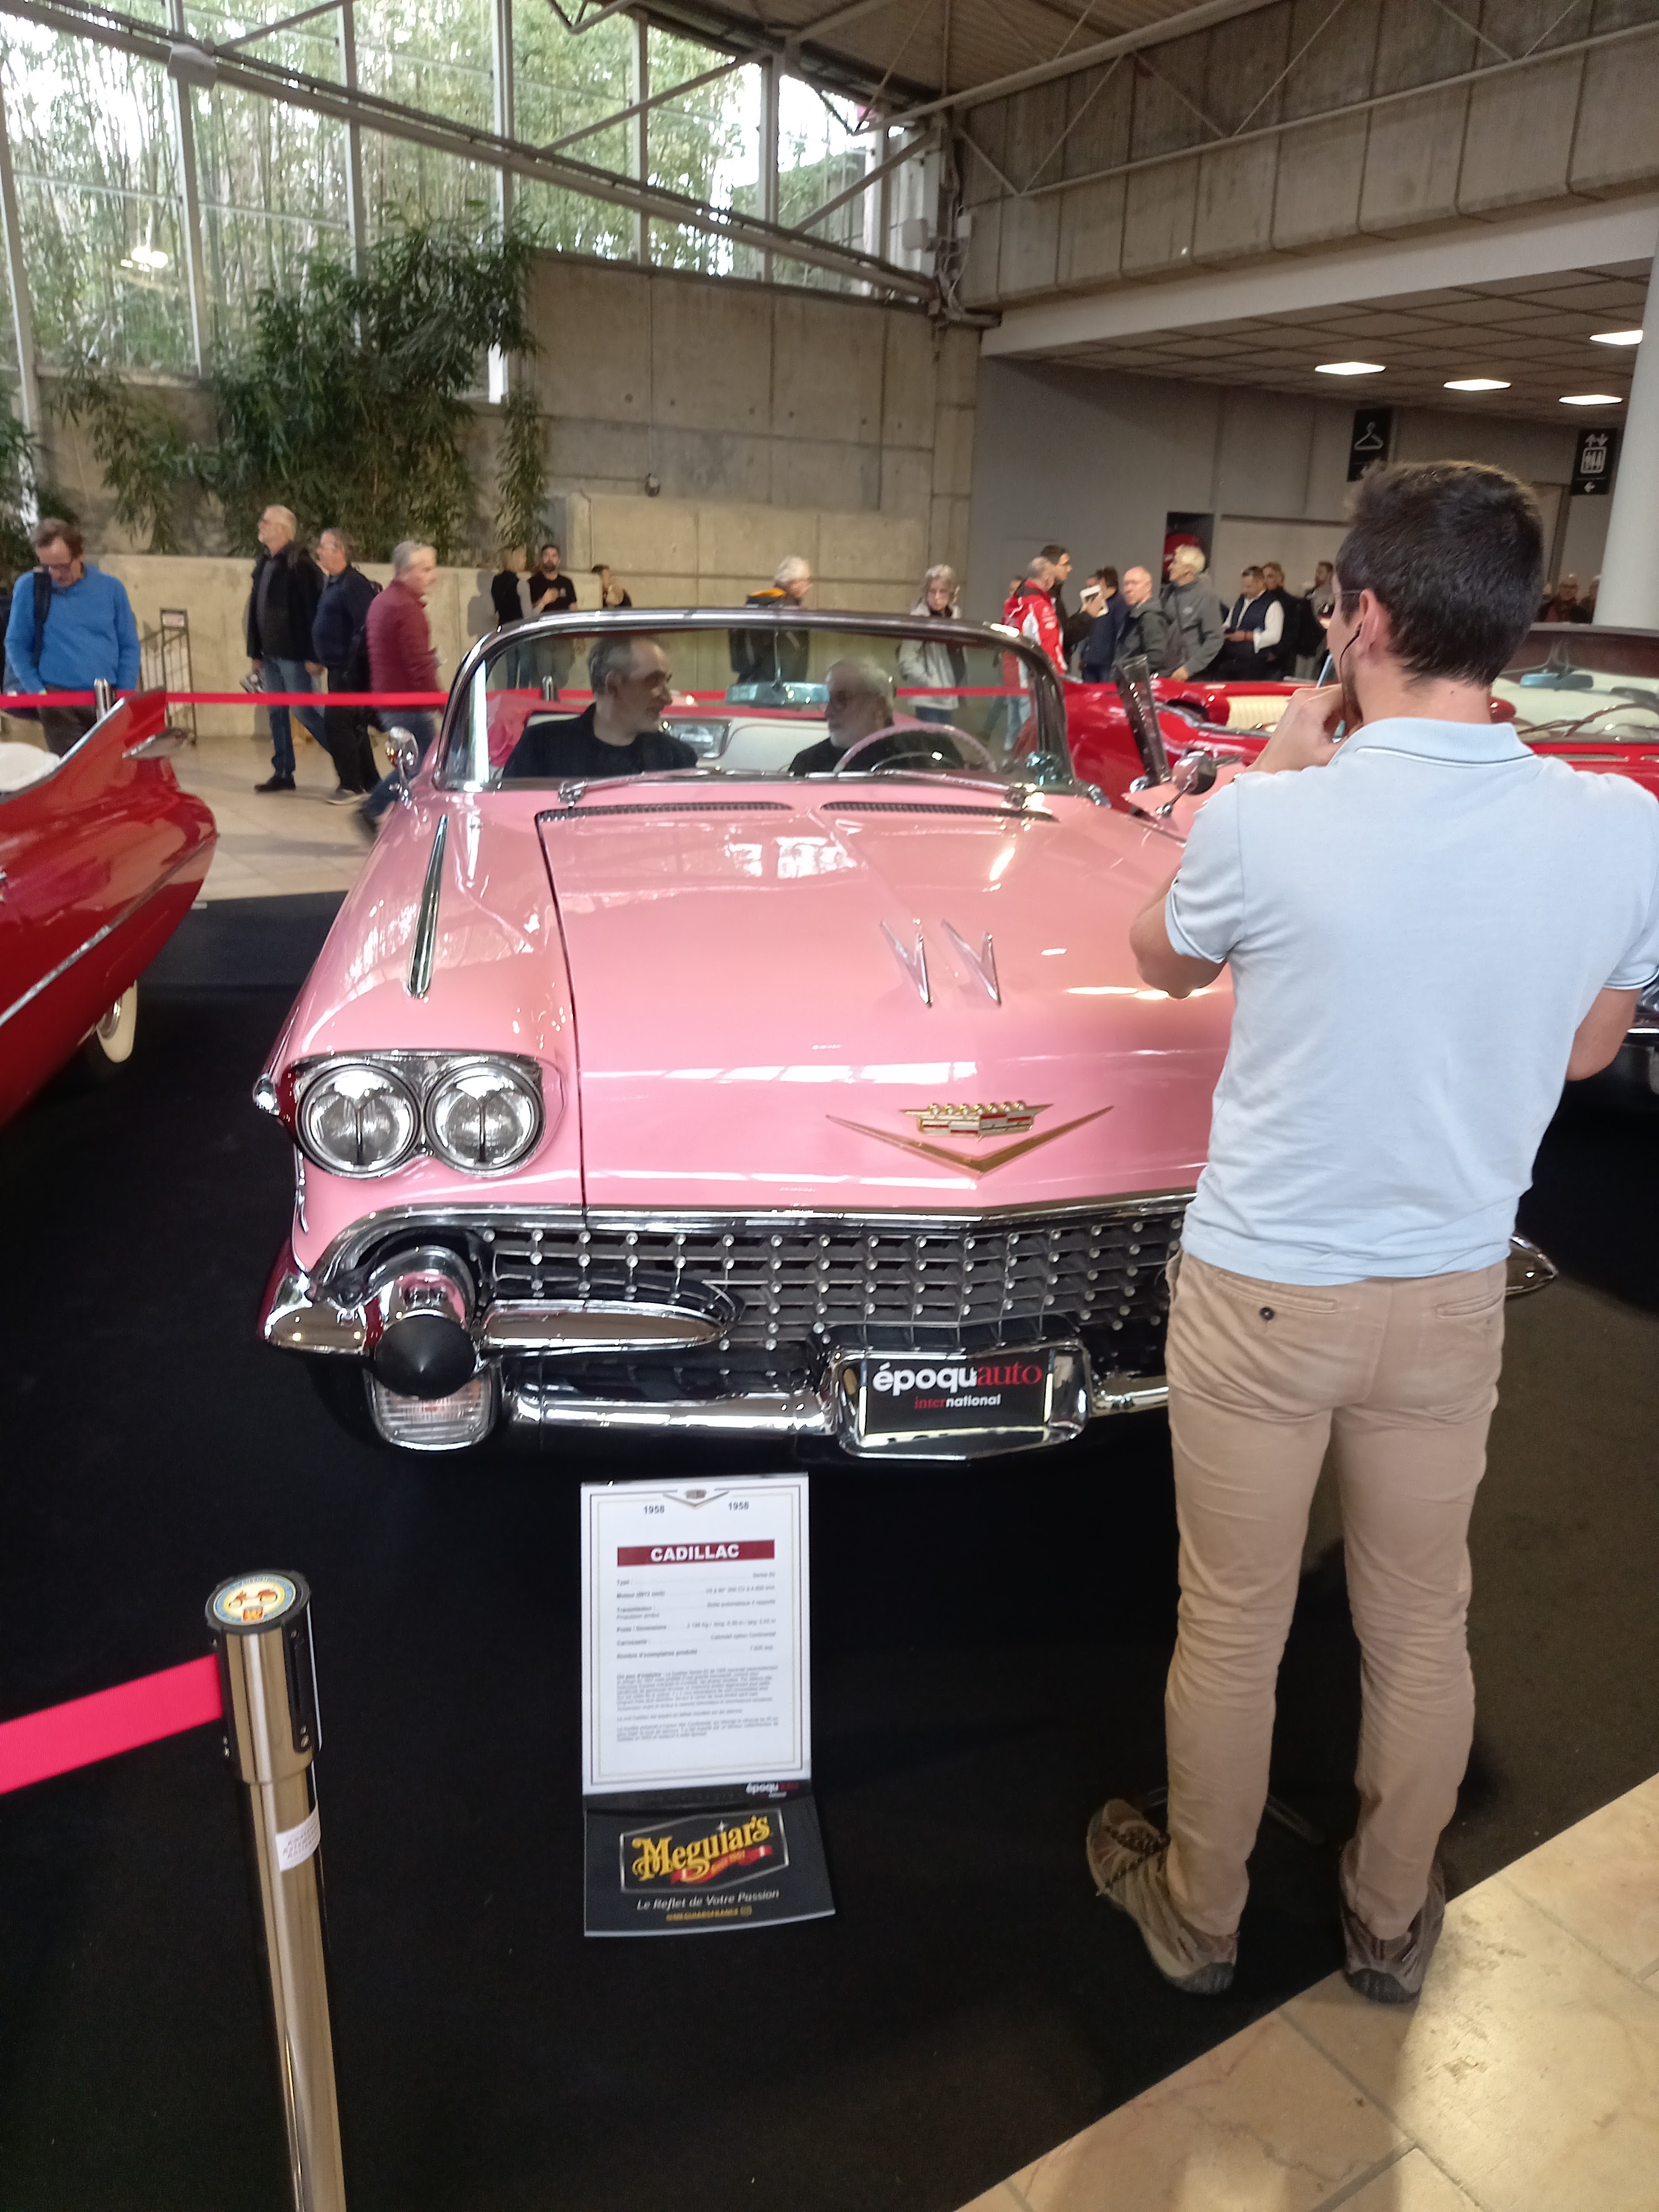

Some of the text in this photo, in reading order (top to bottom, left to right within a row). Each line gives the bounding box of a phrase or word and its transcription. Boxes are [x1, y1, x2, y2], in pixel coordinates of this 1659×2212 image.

[914, 1394, 1001, 1408] international
[650, 1543, 740, 1563] CADILLAC
[637, 1889, 780, 1912] Le Reflet de Votre Passion
